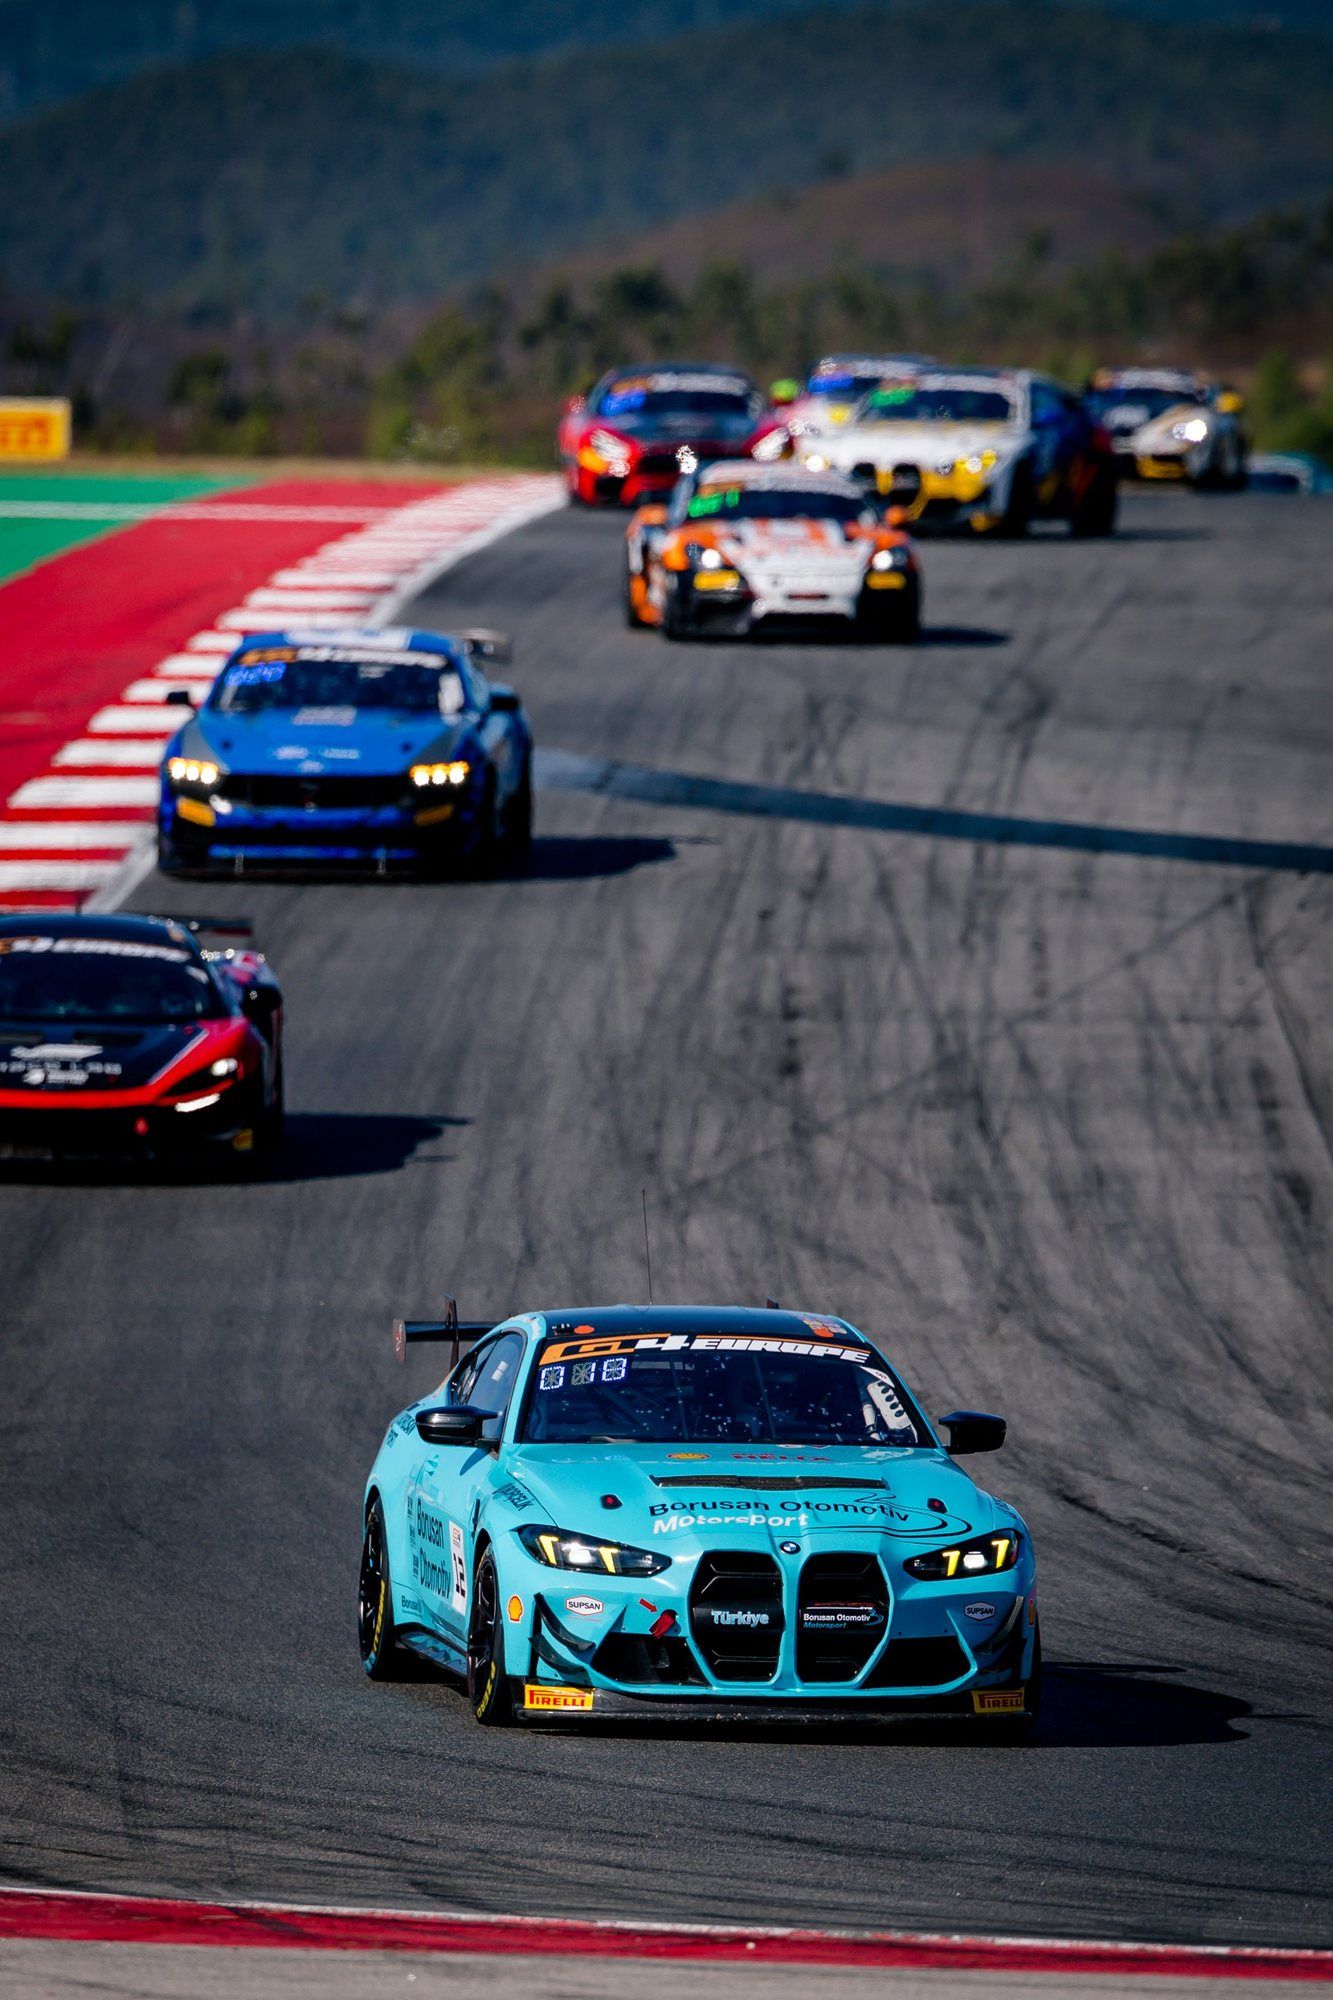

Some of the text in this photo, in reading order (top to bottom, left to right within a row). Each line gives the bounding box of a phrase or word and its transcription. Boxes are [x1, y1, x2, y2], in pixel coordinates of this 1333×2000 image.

[649, 1499, 910, 1522] Borusan Otomotiv
[417, 1498, 444, 1550] Borusan
[653, 1513, 809, 1535] Motorsport
[420, 1547, 451, 1600] Otomotiv
[568, 1601, 601, 1610] SUPSAN
[966, 1607, 994, 1615] SUPSAN
[711, 1610, 770, 1628] Türkiye
[803, 1613, 870, 1621] Borusan Otomotiv
[528, 1689, 586, 1708] PIRELLI
[977, 1692, 1023, 1708] PIRELLI
